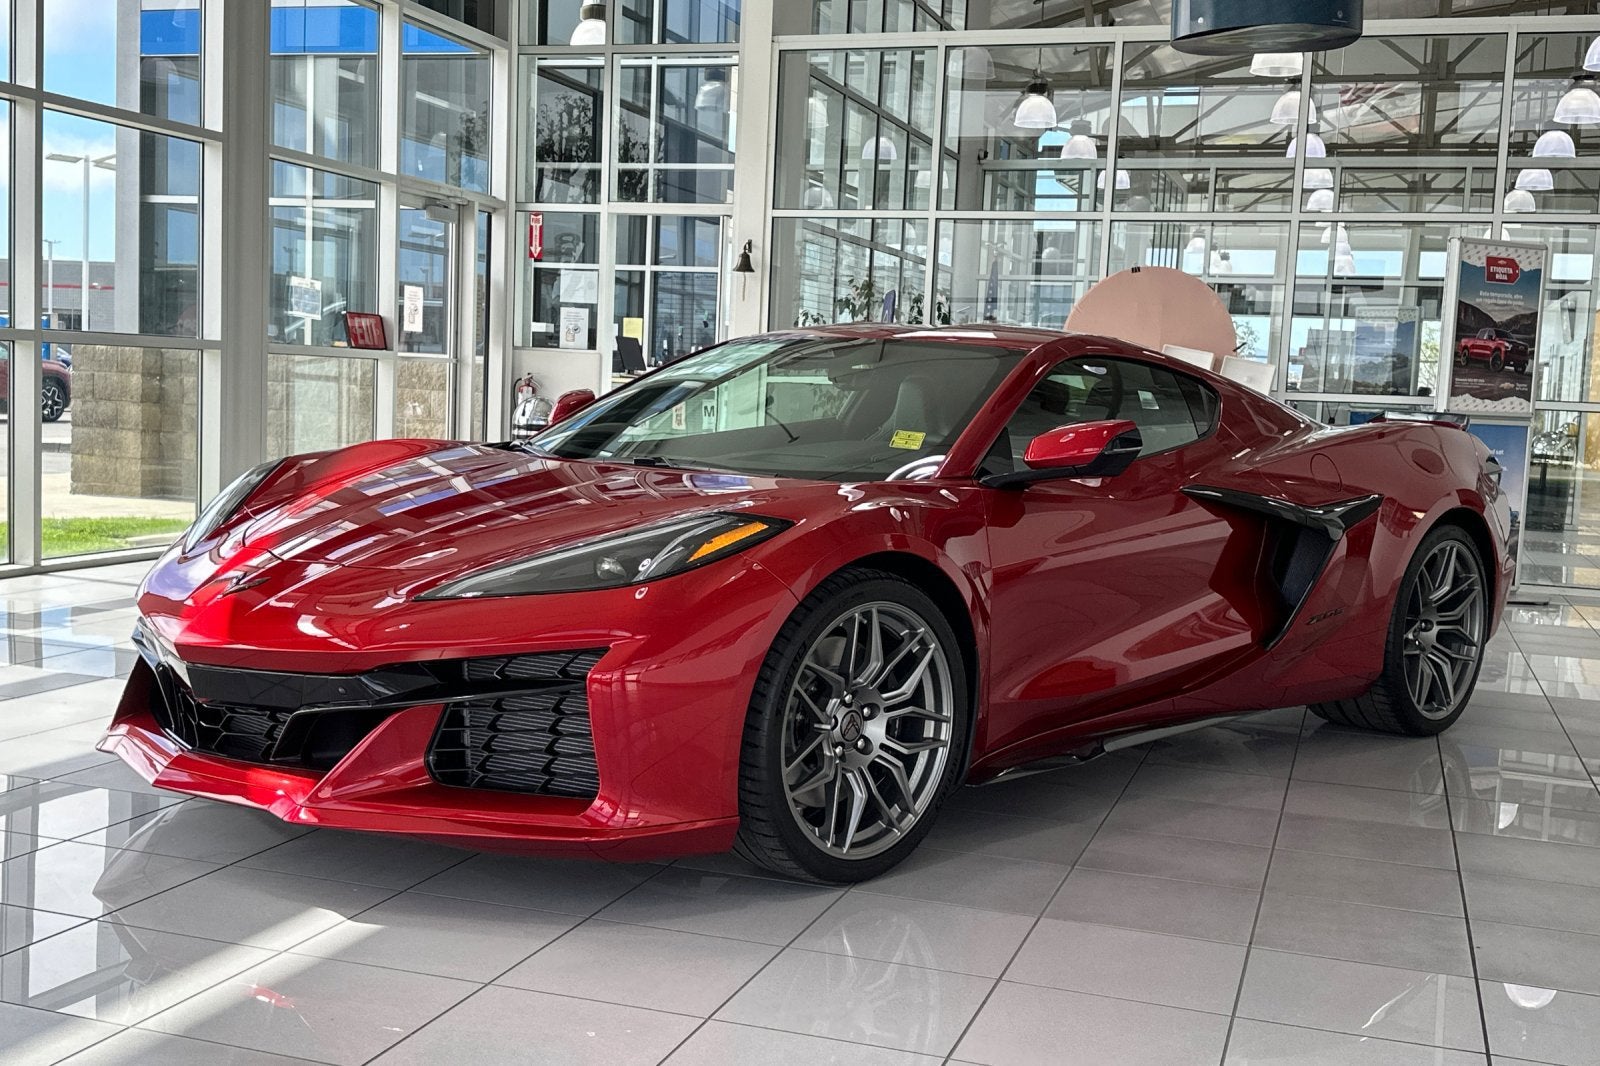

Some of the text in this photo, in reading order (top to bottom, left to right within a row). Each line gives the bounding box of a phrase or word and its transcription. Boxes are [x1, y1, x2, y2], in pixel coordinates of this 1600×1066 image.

[1490, 266, 1513, 274] ETIQUETA
[354, 317, 379, 345] EXIT
[704, 405, 715, 417] M
